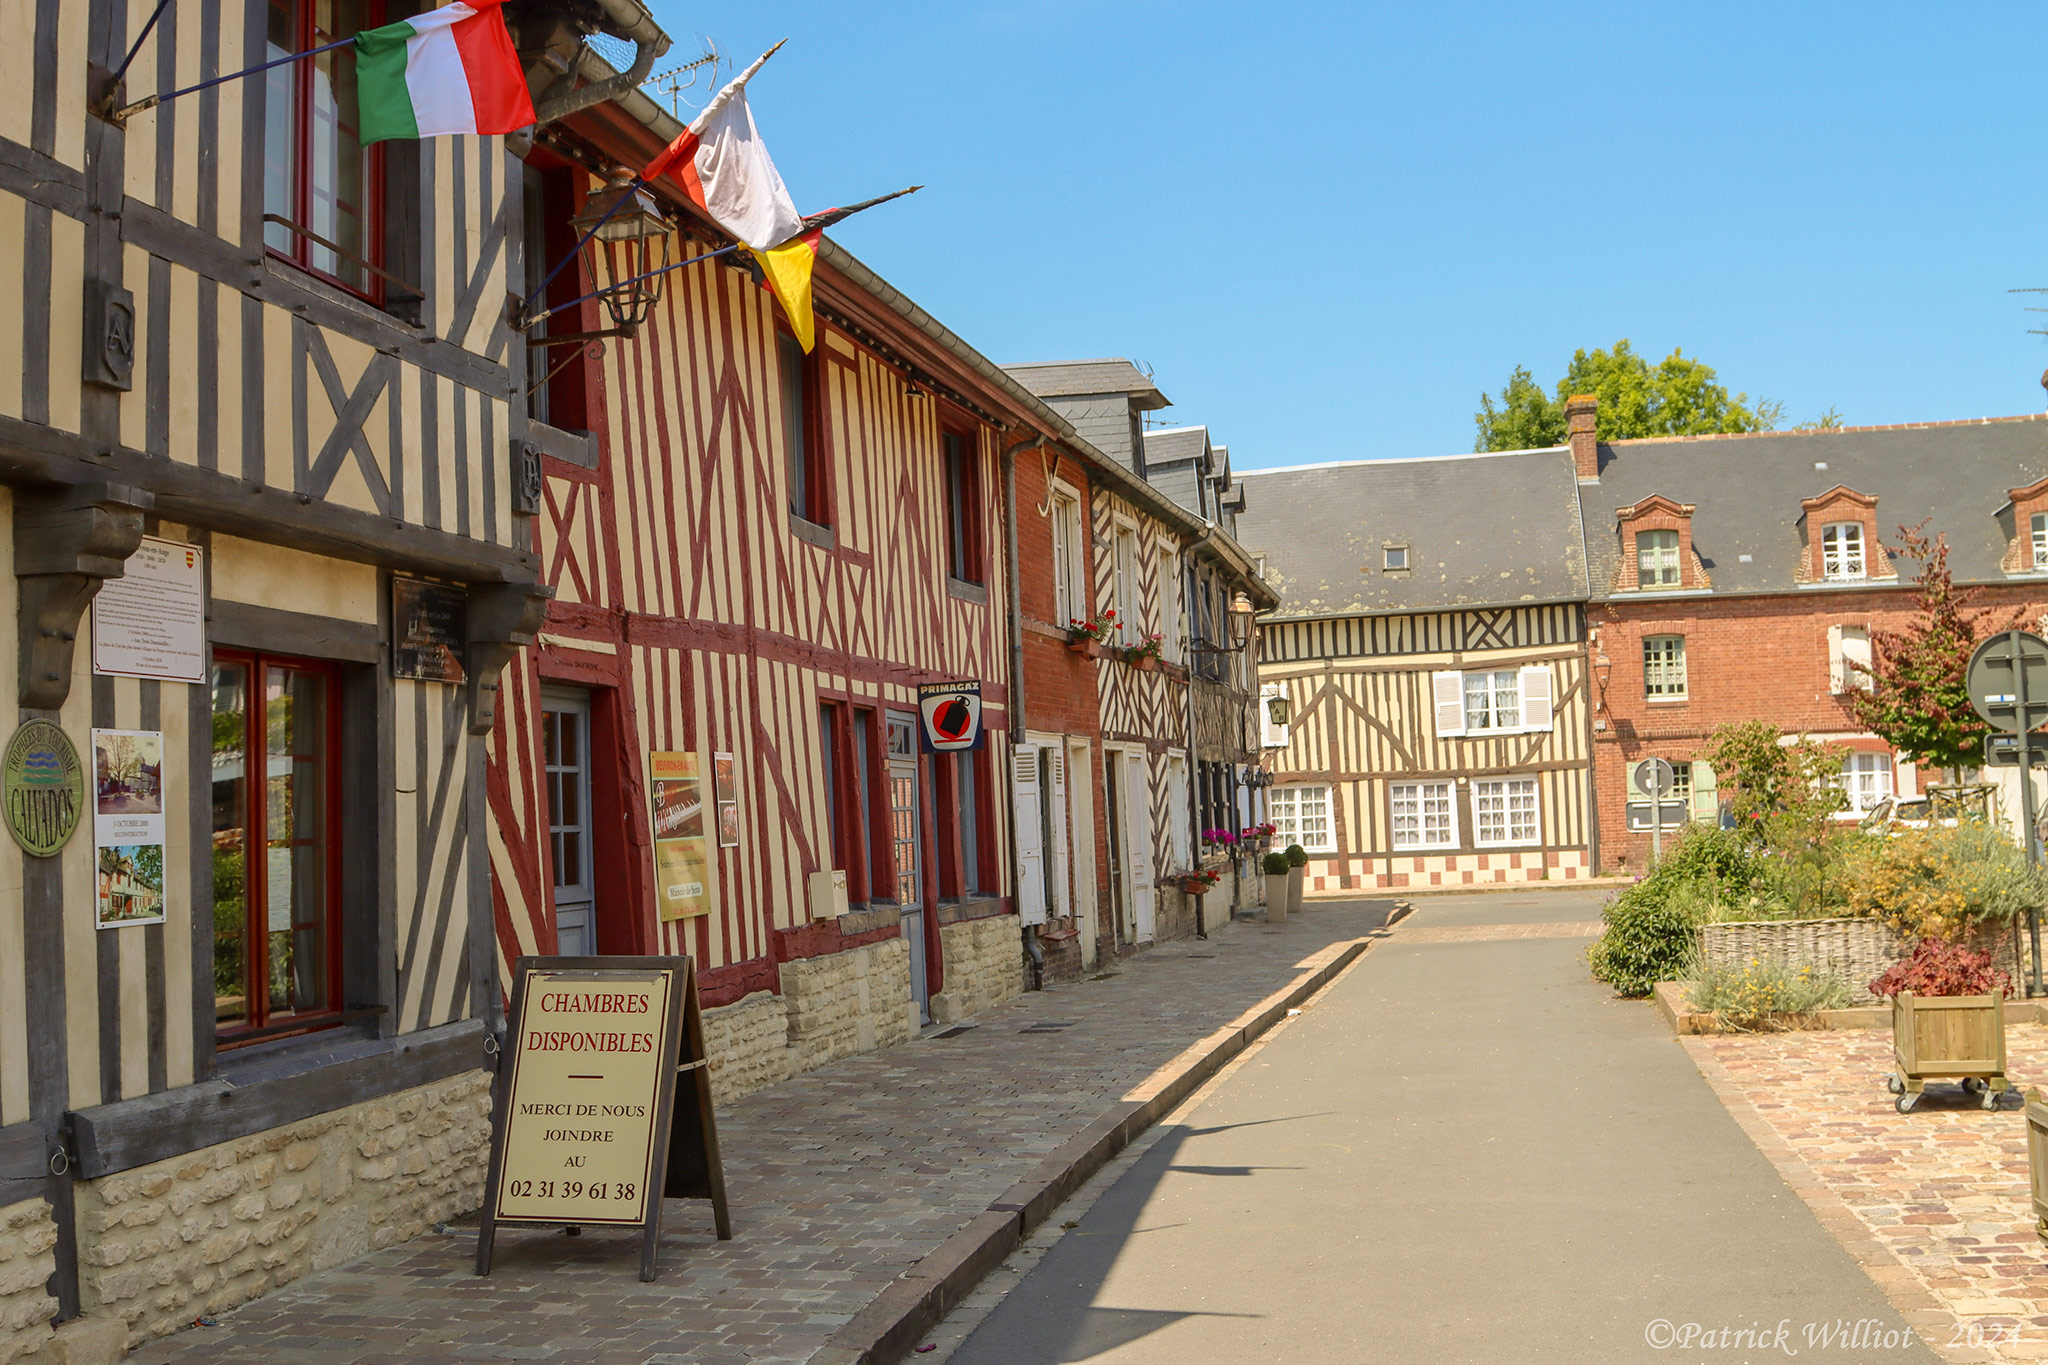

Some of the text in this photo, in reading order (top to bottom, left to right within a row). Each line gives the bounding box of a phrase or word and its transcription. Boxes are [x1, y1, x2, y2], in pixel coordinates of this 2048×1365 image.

[920, 681, 980, 694] PRIMAGAZ
[12, 788, 74, 848] CALVADOS
[541, 992, 650, 1014] CHAMBRES
[527, 1031, 654, 1053] DISPONIBLES
[520, 1103, 645, 1117] MERCI DE NOUS
[543, 1130, 614, 1143] JOINDRE
[564, 1155, 587, 1168] AU
[510, 1180, 636, 1201] 02 31 39 61 38
